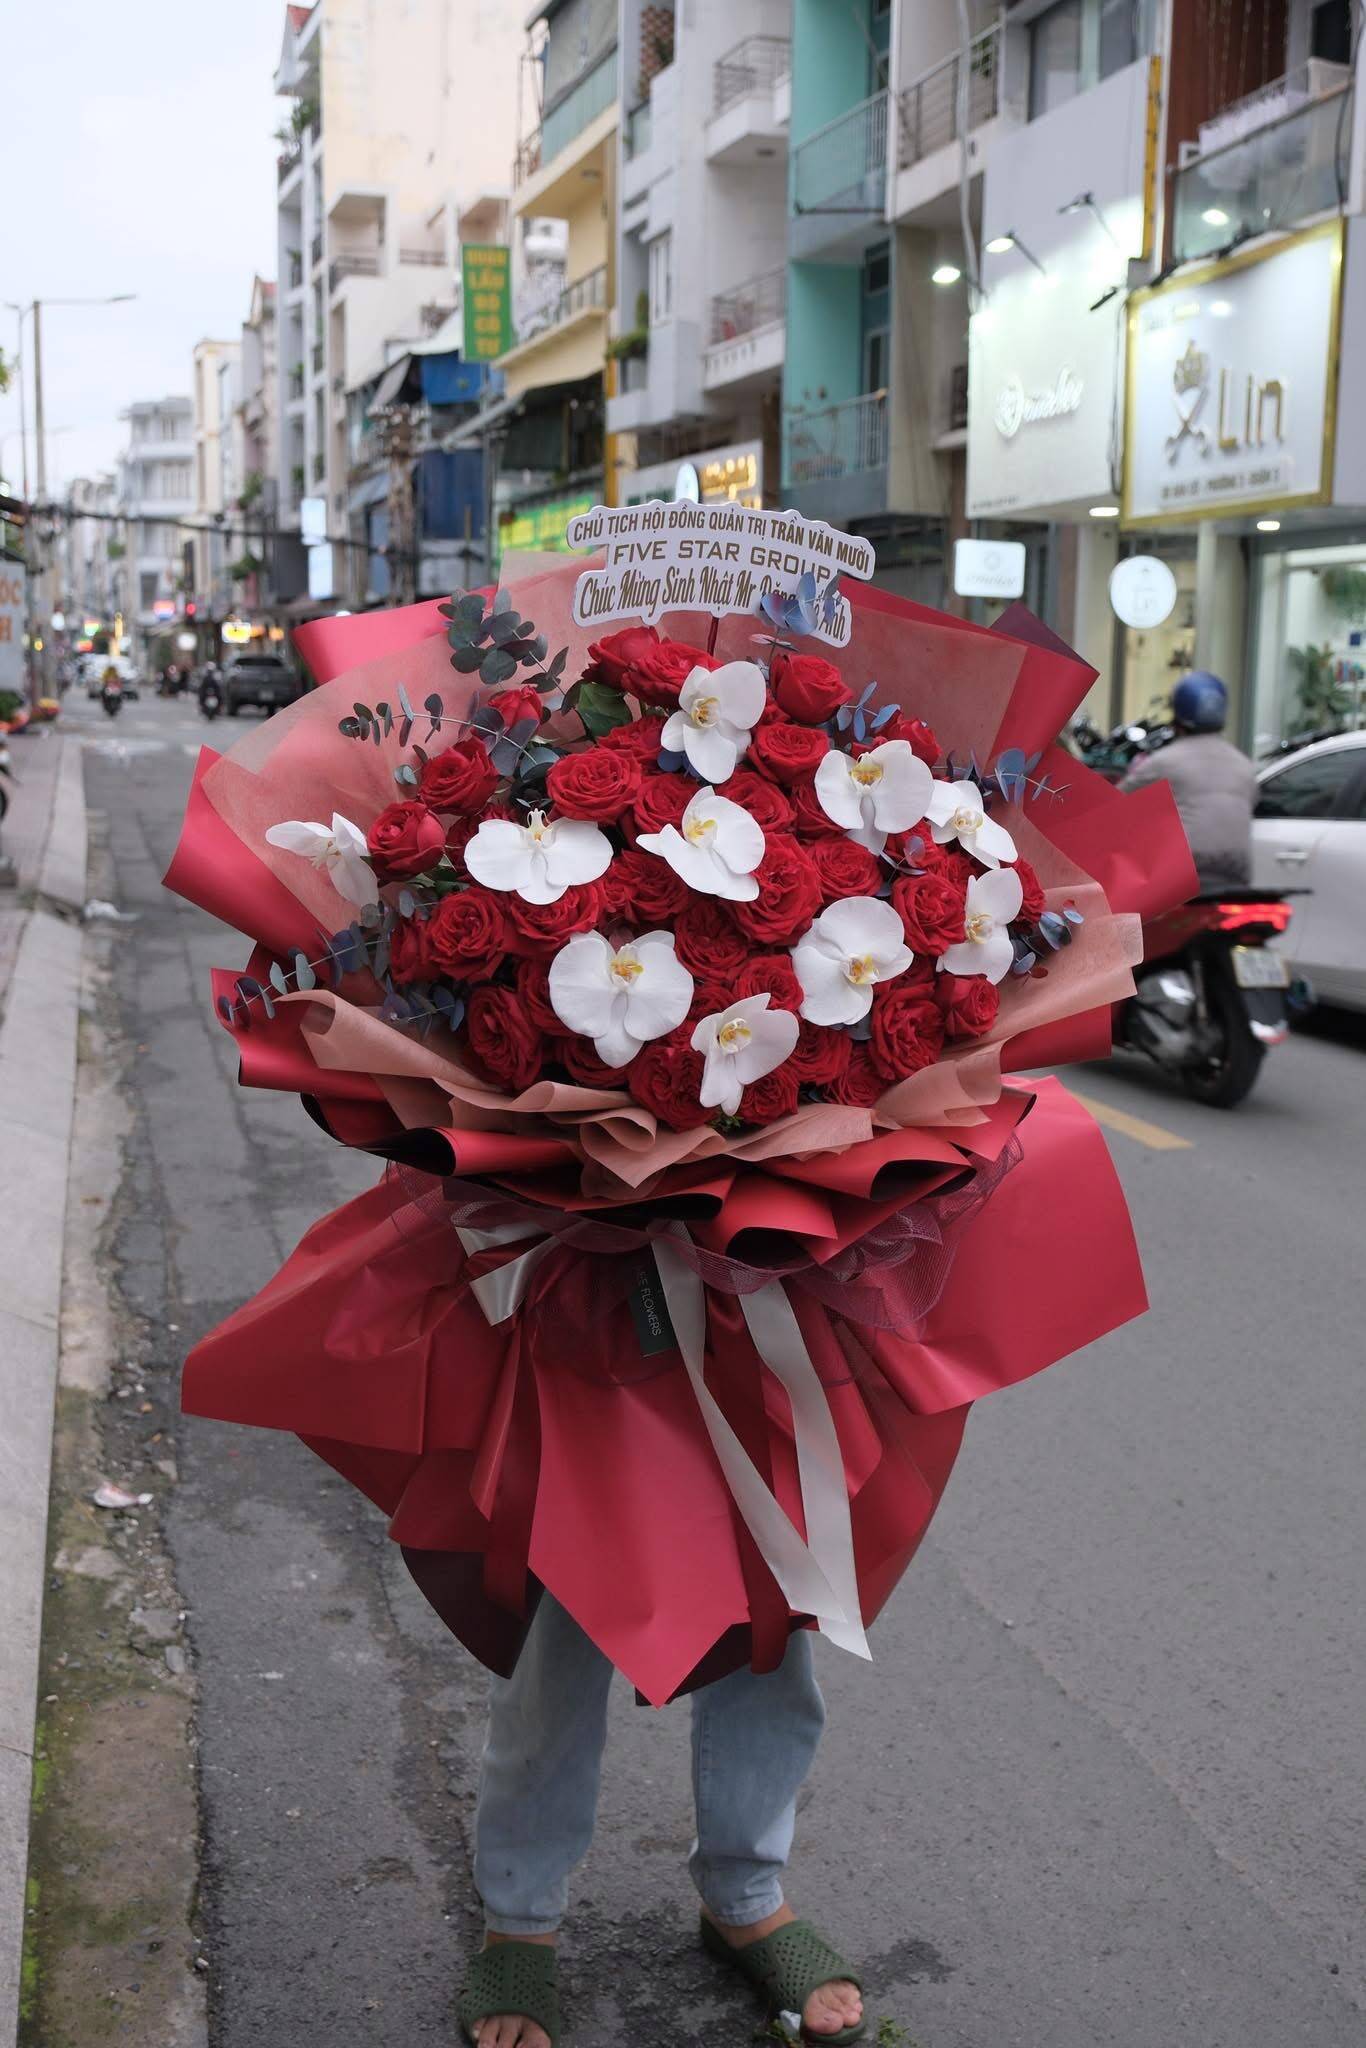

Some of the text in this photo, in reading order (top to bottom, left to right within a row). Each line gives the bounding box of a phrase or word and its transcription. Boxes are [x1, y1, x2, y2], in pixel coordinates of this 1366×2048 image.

[574, 513, 604, 542] CHỦ
[608, 512, 638, 538] TỊCH
[642, 507, 665, 534] HỘI
[668, 504, 706, 529] ĐỒNG
[709, 508, 744, 532] QUẢN
[748, 516, 767, 541] TRỊ
[771, 516, 804, 546] TRẦN
[809, 529, 834, 556] VĂN
[836, 541, 870, 573] MƯỜI
[613, 540, 832, 584] FIVE STAR GROUP
[580, 575, 616, 619] Chúc
[617, 568, 662, 618] Mừng
[662, 565, 697, 605] Sinh
[698, 565, 735, 612] Nhật
[733, 569, 757, 609] Mr
[641, 1288, 661, 1336] FLOWERS
